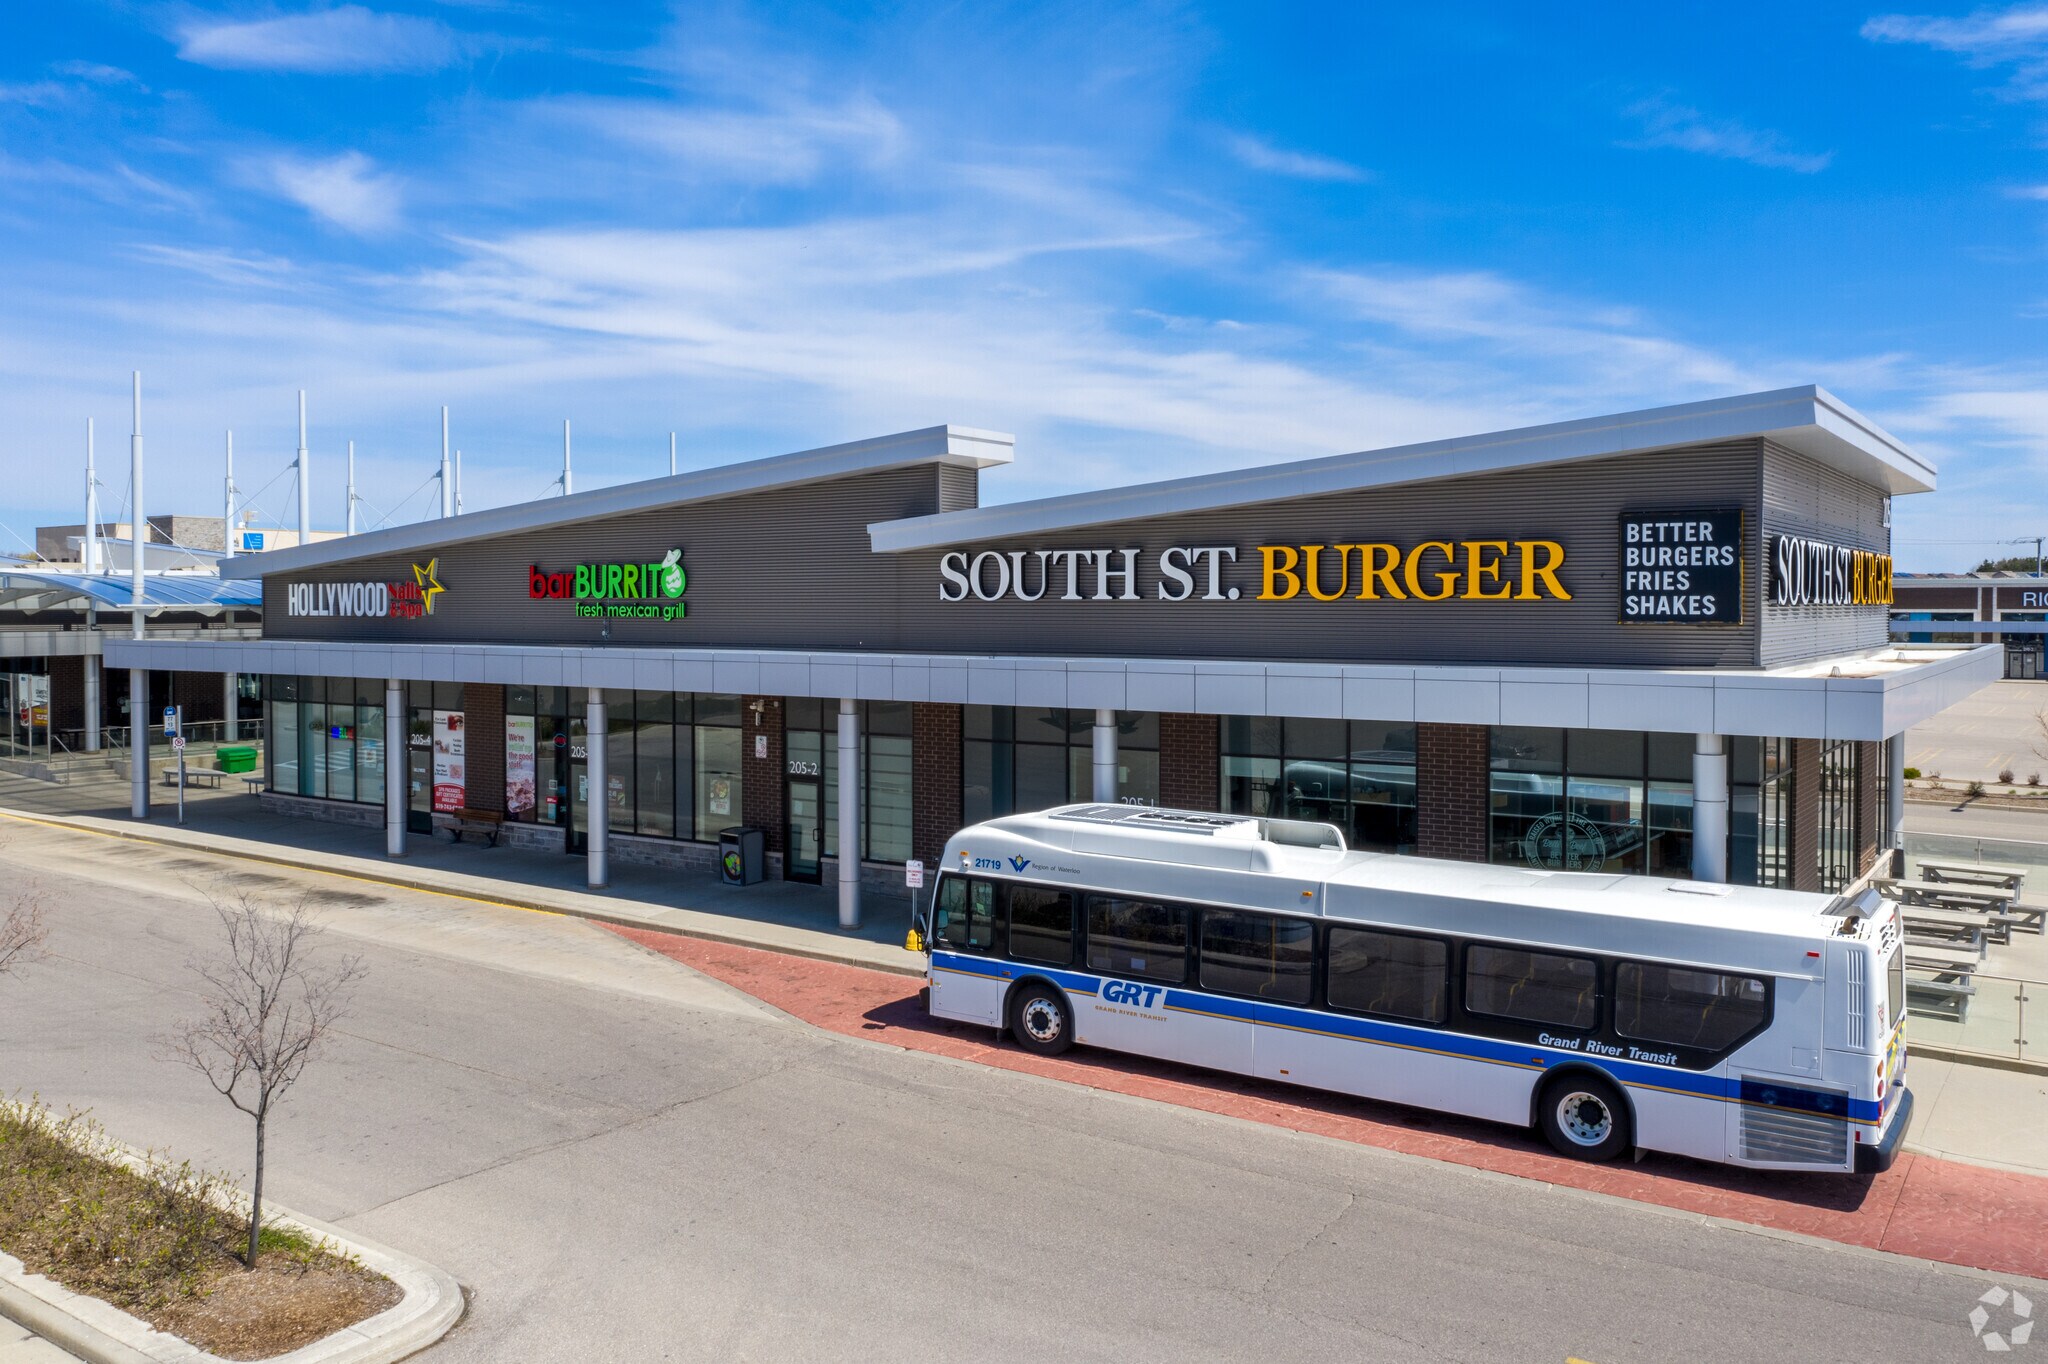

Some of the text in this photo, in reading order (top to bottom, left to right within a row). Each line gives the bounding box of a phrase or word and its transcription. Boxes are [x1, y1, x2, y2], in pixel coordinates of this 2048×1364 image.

[1626, 522, 1713, 543] BETTER
[1626, 545, 1734, 567] BURGERS
[939, 541, 1573, 602] SOUTH ST. BURGER
[1778, 535, 1894, 606] SOUTH ST. BURGER
[1626, 571, 1690, 591] FRIES
[288, 582, 387, 617] HOLLYWOOD
[1625, 595, 1716, 615] SHAKES
[2023, 592, 2048, 607] RI
[575, 603, 685, 622] fresh mexican grill
[571, 746, 588, 758] 205-
[790, 761, 818, 775] 205-2
[1529, 822, 1545, 841] RAISED
[1586, 826, 1598, 838] USE
[975, 858, 1002, 870] 21719
[1032, 863, 1049, 871] Region
[1102, 980, 1163, 1008] GRT
[1095, 1005, 1168, 1022] GRAND RIVER TRANSIT
[1538, 1033, 1677, 1065] Grand River Transit
